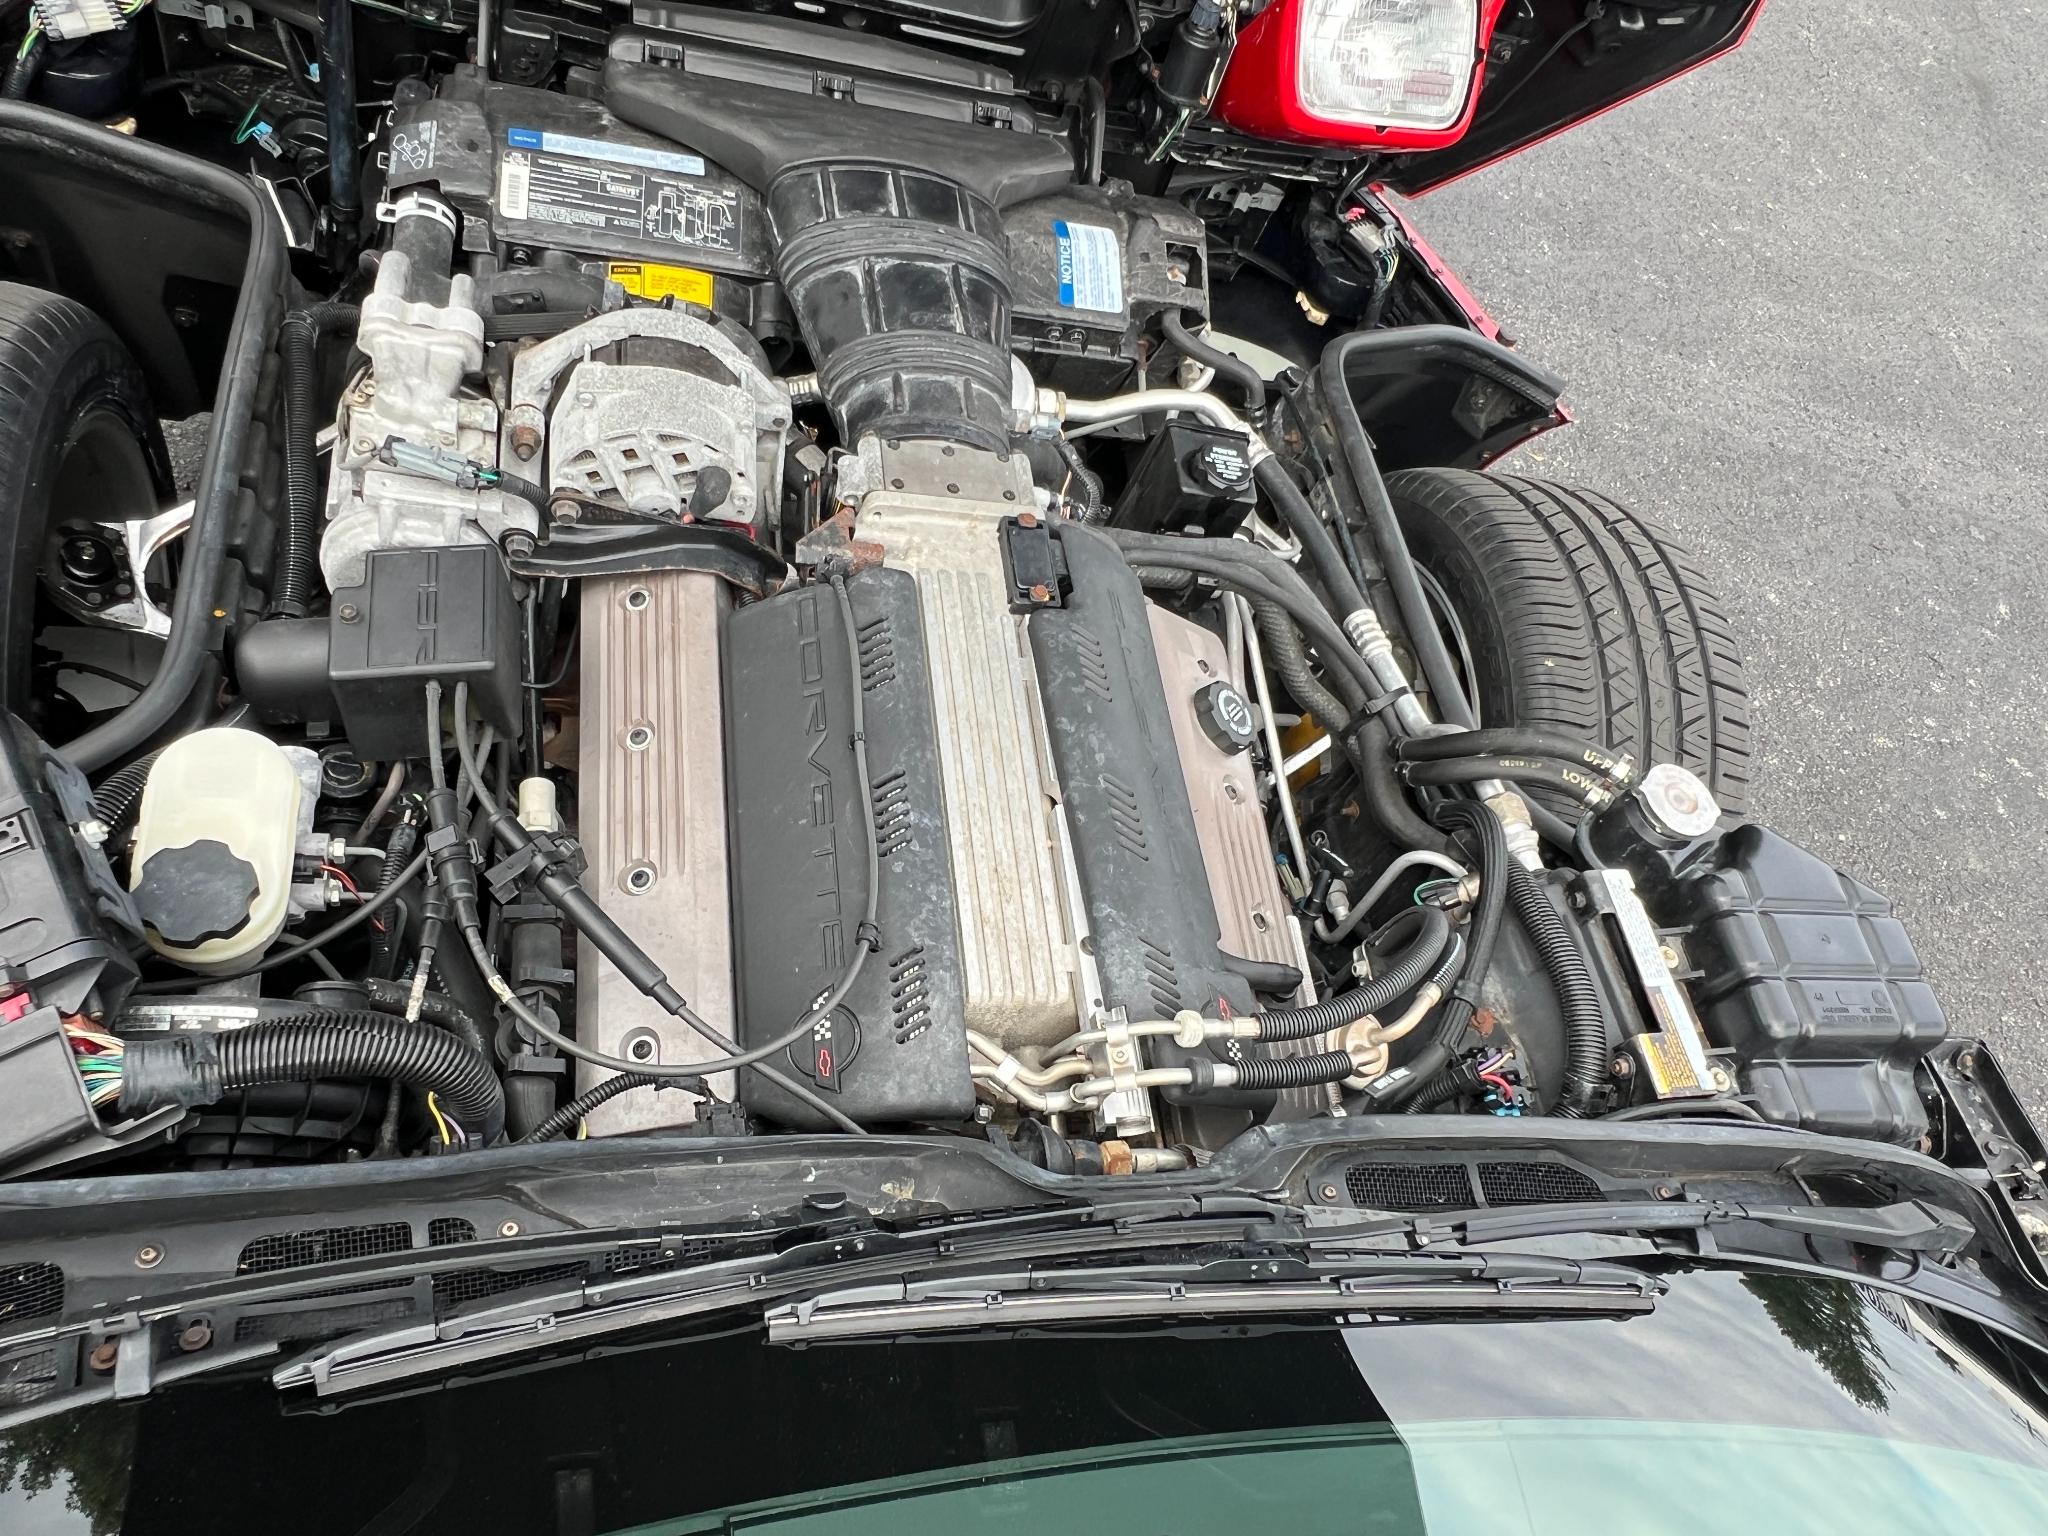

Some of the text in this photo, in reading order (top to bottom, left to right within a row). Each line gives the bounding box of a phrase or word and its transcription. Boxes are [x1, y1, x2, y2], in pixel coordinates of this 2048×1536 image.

[1060, 237, 1074, 285] NOTICE
[799, 595, 846, 969] CORVETTE
[1561, 768, 1612, 803] LOWR
